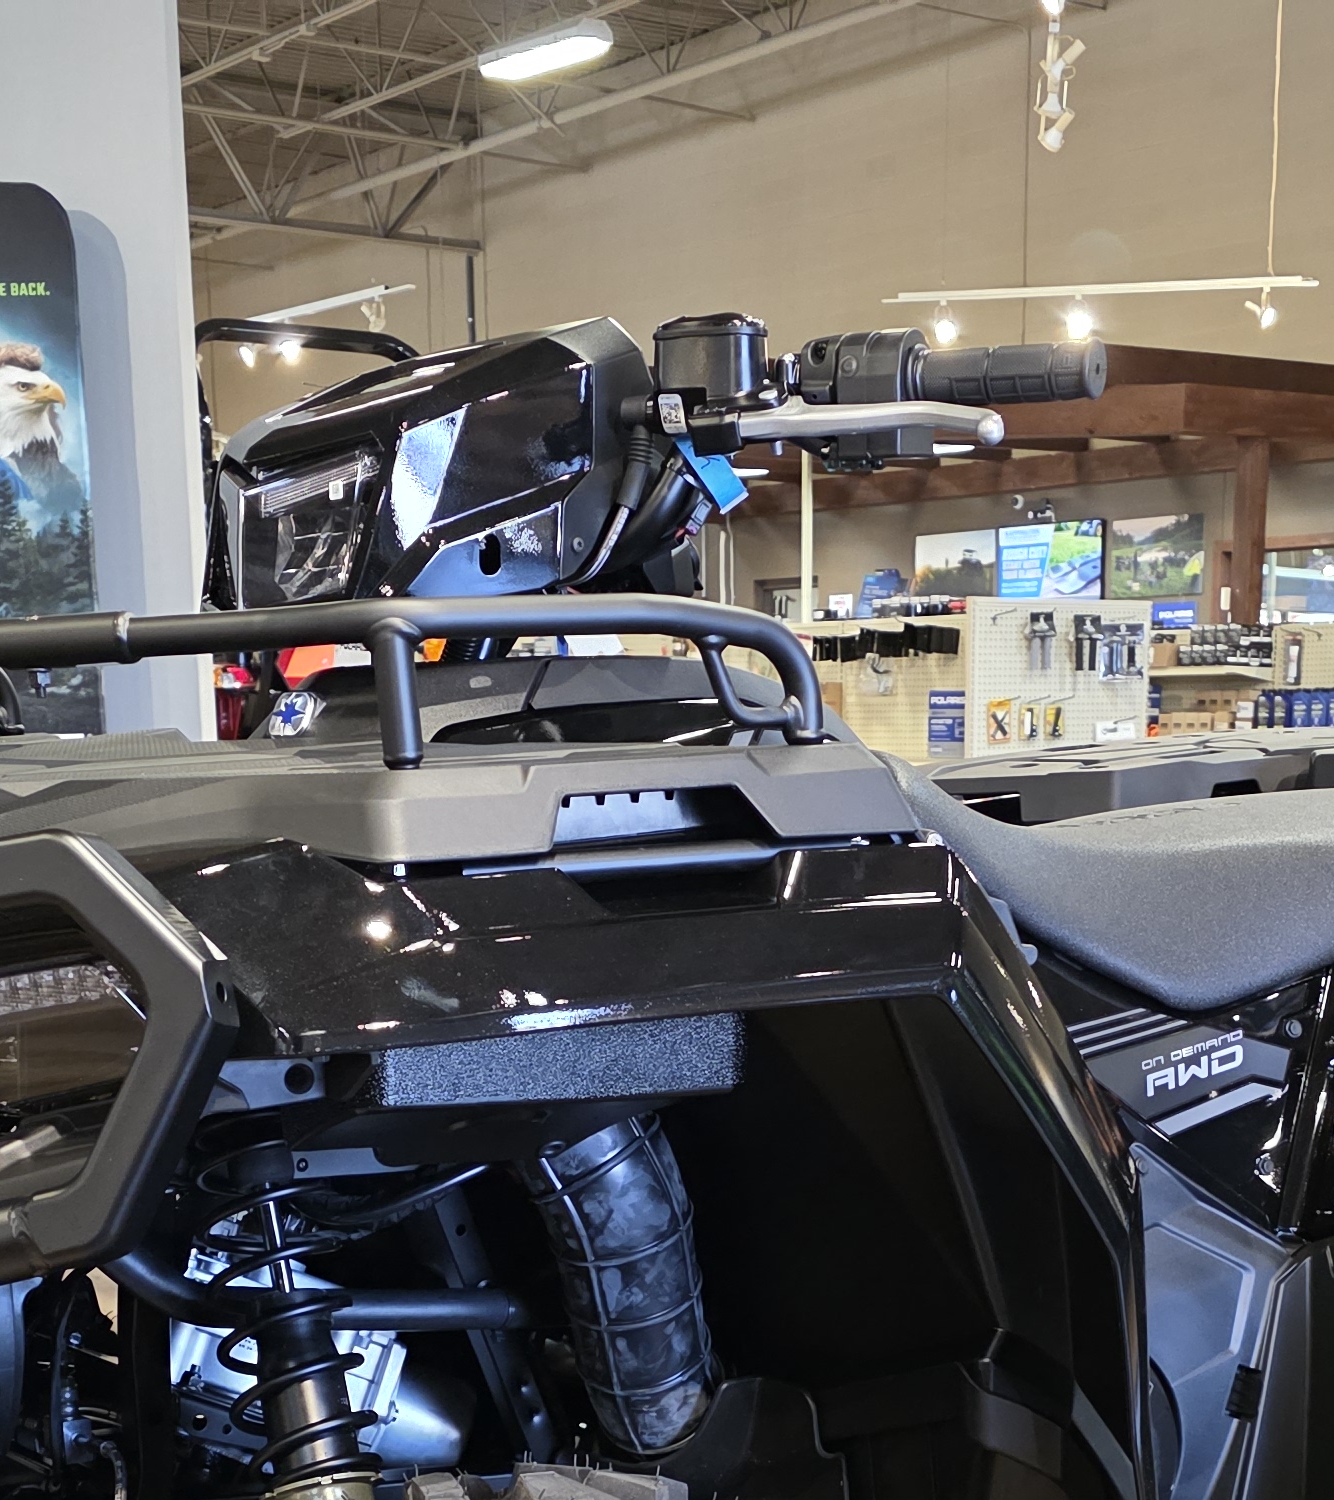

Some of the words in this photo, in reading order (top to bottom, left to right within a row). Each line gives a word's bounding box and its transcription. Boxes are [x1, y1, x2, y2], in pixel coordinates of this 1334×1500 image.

[11, 282, 51, 296] BACK.
[1141, 1055, 1165, 1071] ON
[1170, 1029, 1244, 1062] DEMAND
[1146, 1044, 1244, 1097] AWD
